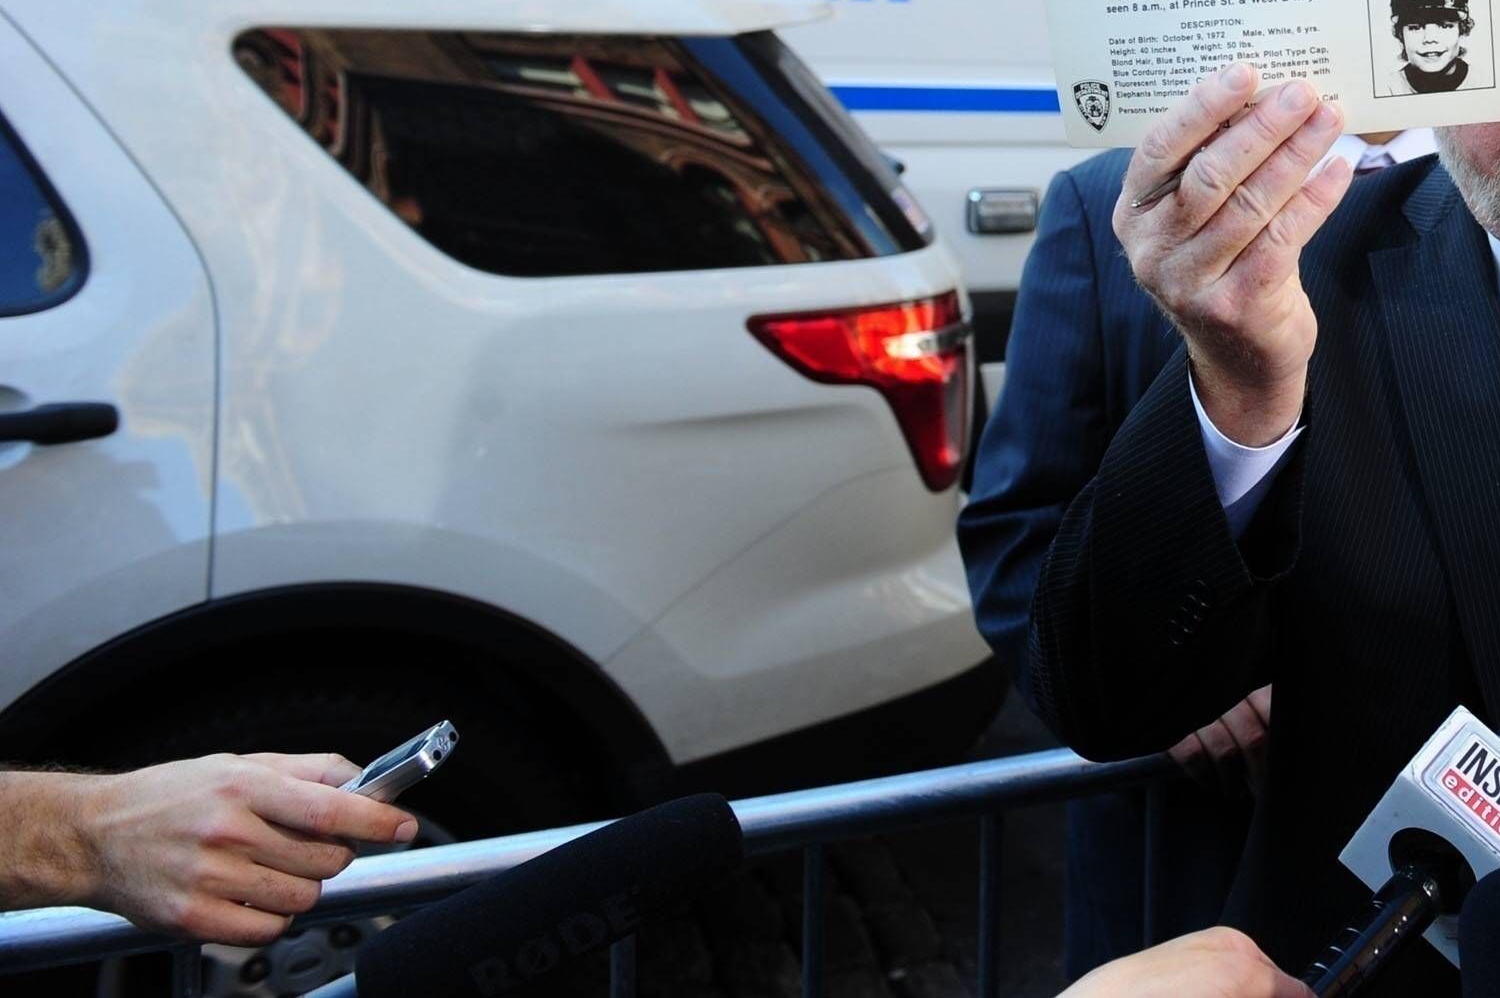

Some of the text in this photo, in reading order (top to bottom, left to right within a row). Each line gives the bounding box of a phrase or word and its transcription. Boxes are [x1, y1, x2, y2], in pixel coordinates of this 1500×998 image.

[1106, 4, 1129, 13] seen
[1132, 2, 1138, 11] 8
[1169, 1, 1179, 9] at
[1180, 19, 1245, 29] DESCRIPTION:
[1109, 37, 1125, 45] Date
[1138, 36, 1159, 44] Birth:
[1162, 34, 1194, 42] October
[1207, 31, 1225, 40] 1972
[1243, 29, 1265, 37] Male,
[1268, 27, 1294, 35] White,
[1305, 25, 1320, 34] yrs.
[1110, 48, 1137, 57] Height:
[1192, 43, 1222, 52] Weight:
[1112, 58, 1133, 66] Blond
[1176, 56, 1197, 64] Eyes,
[1200, 52, 1233, 61] Wearing
[1237, 51, 1259, 59] Black
[1263, 49, 1282, 57] Pilot
[1285, 47, 1306, 57] Type
[1113, 69, 1129, 77] Blue
[1132, 68, 1166, 77] Corduroy
[1200, 65, 1217, 73] Blue
[1270, 59, 1309, 68] Sneakers
[1312, 57, 1330, 65] with
[1114, 80, 1156, 88] Fluorescent
[1262, 71, 1285, 80] Cloth
[1291, 69, 1307, 78] Bag
[1313, 67, 1331, 75] with
[1116, 90, 1151, 99] Elephants
[1322, 93, 1339, 101] Call
[1118, 106, 1146, 114] Persons
